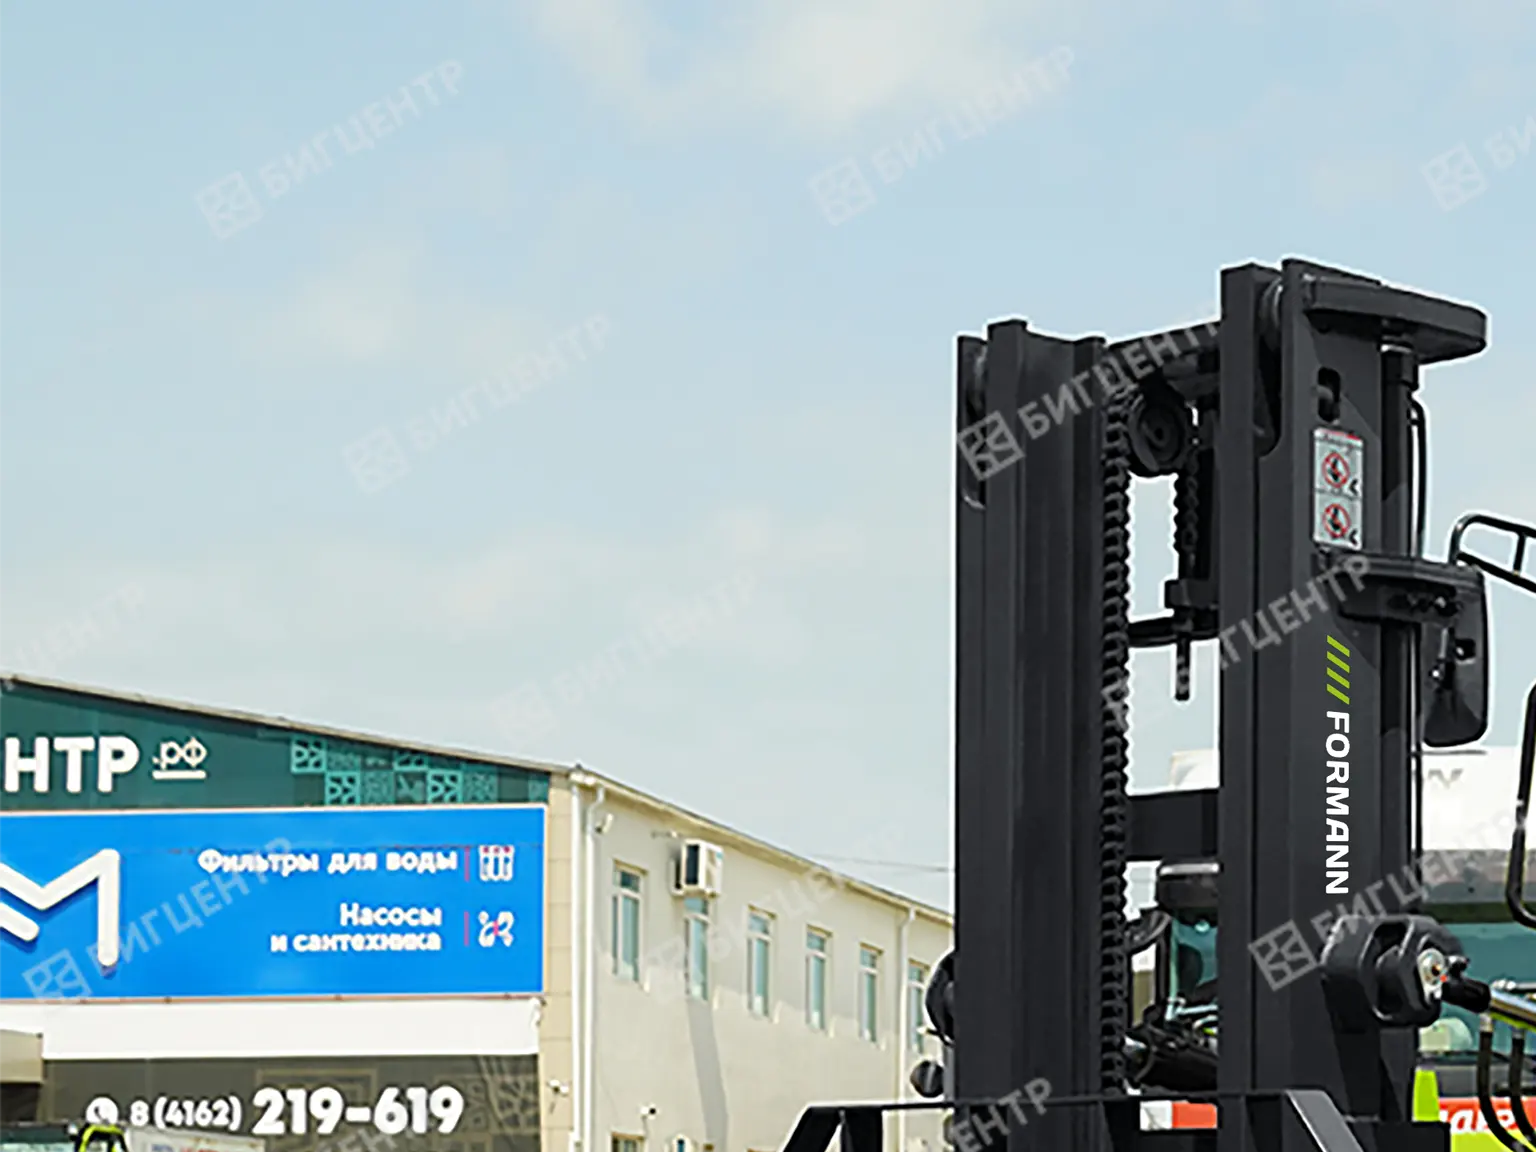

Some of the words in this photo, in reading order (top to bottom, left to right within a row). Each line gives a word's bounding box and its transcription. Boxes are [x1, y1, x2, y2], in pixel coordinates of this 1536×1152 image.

[1325, 711, 1350, 895] FORMANN
[198, 848, 319, 877] Фильтры
[327, 851, 378, 874] для
[386, 850, 457, 873] воды
[339, 902, 442, 926] Насосы
[270, 935, 288, 952] и
[292, 932, 442, 951] сантехника
[129, 1100, 149, 1126] 8
[154, 1096, 242, 1130] (4162)
[252, 1085, 464, 1135] 219-619
